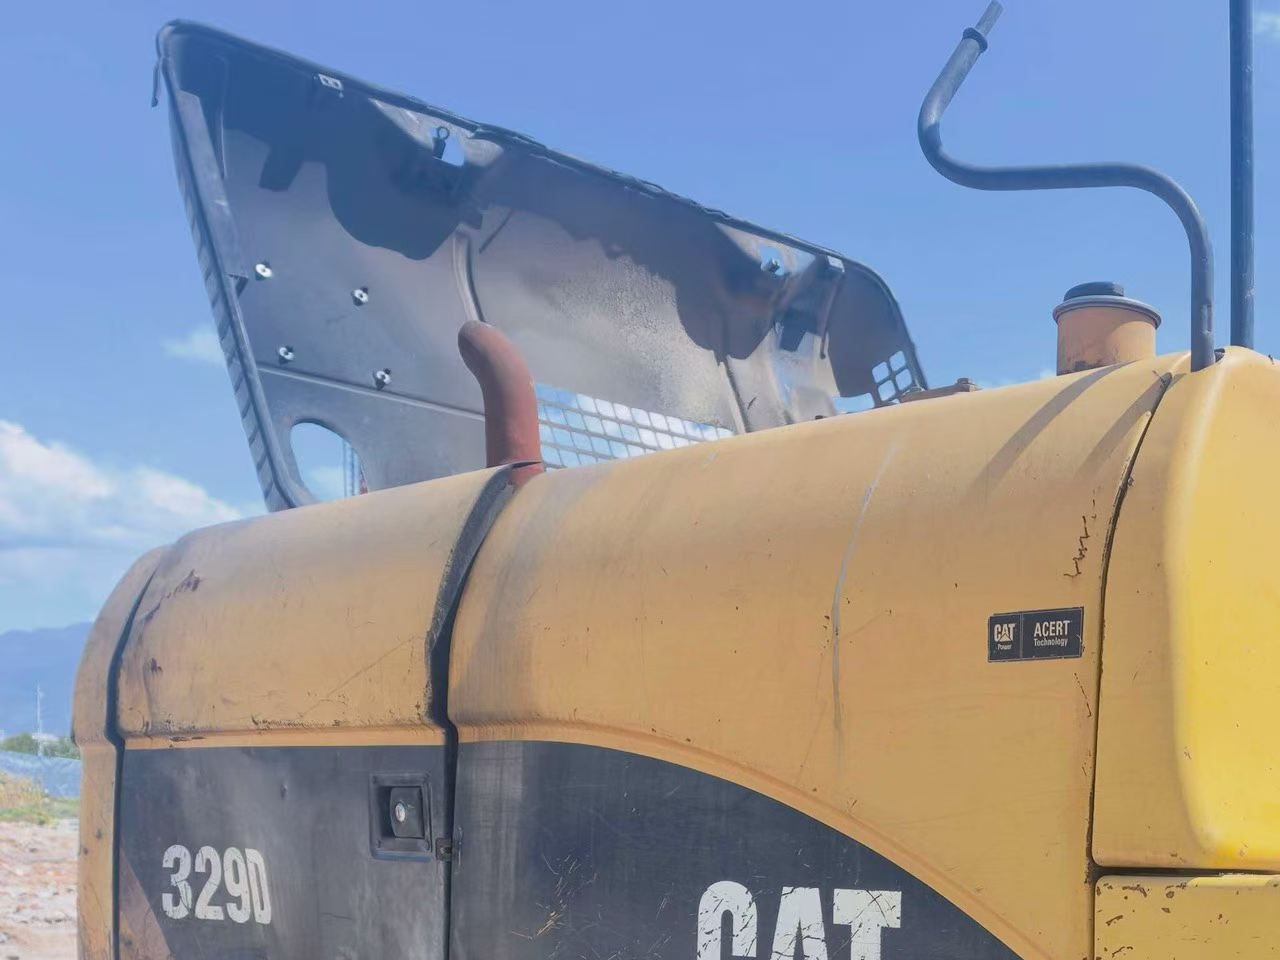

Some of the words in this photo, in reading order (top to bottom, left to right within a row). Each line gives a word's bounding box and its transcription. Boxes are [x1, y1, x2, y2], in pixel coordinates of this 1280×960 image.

[994, 623, 1016, 642] CAT
[1033, 620, 1071, 637] ACERT
[1033, 637, 1069, 647] Technology
[162, 844, 272, 925] 329D
